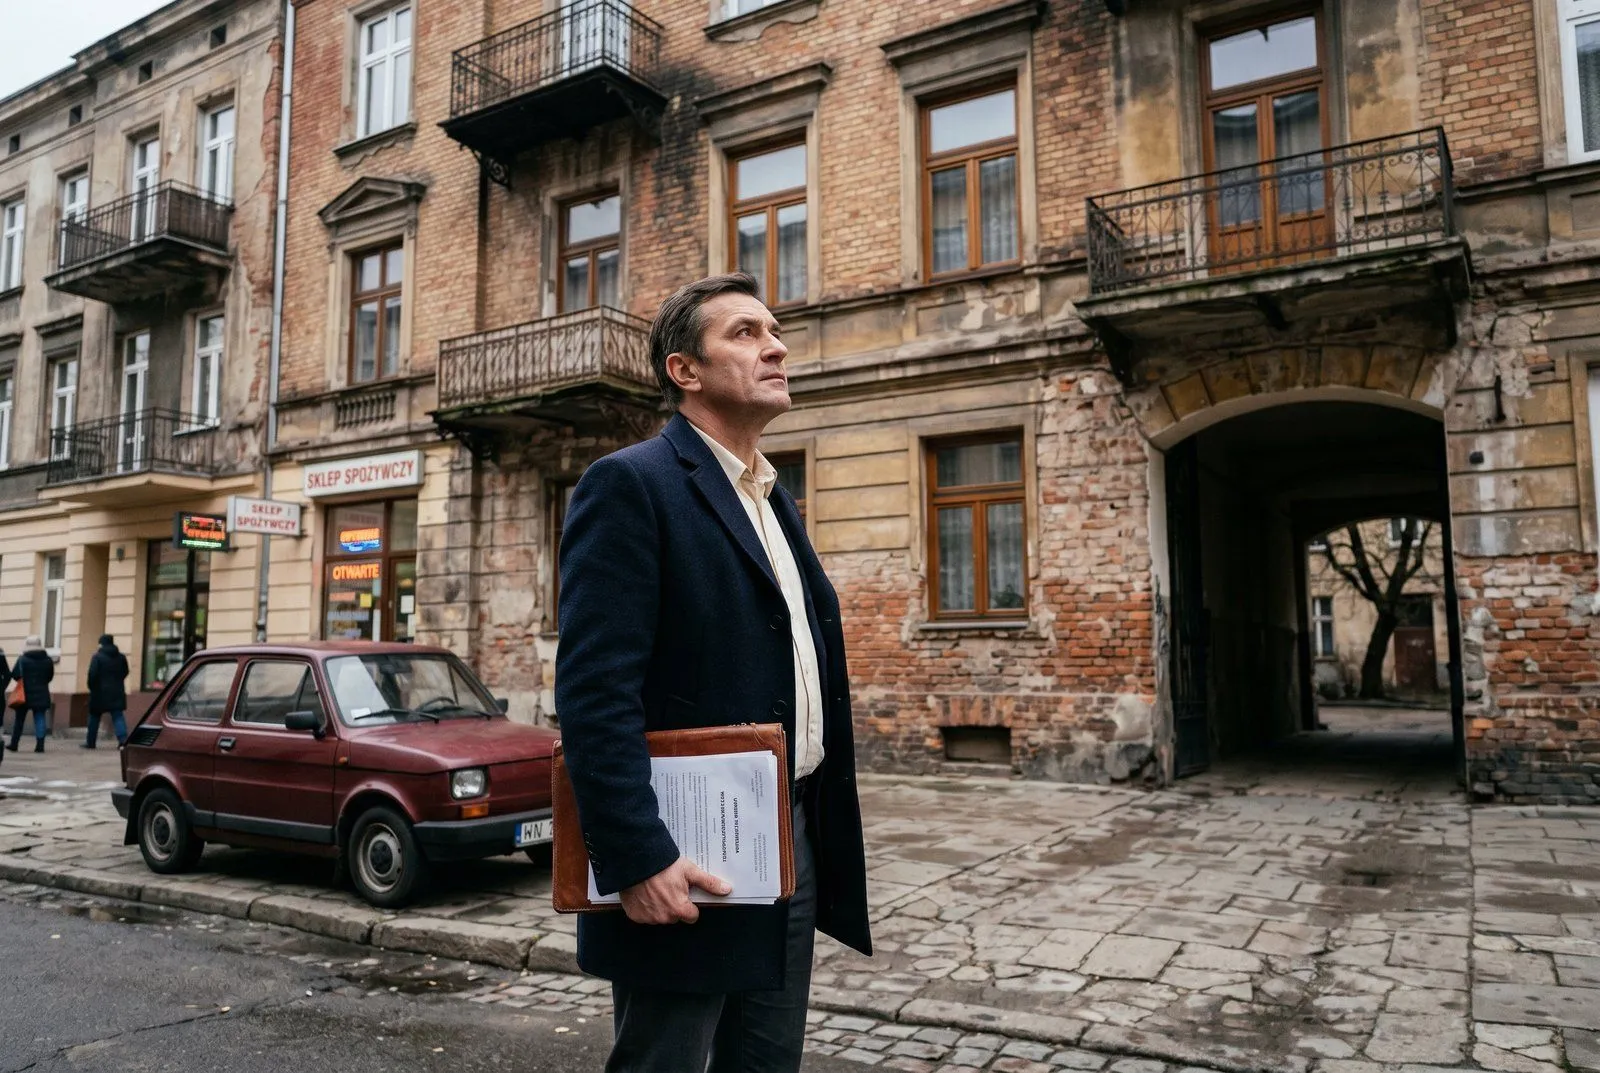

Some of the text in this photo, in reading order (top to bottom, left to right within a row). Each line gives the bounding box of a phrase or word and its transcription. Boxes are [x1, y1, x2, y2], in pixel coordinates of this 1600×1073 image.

[307, 470, 341, 489] SKLEP
[252, 504, 282, 515] SKLEP
[332, 563, 380, 580] OTWARTE
[524, 822, 543, 840] WN
